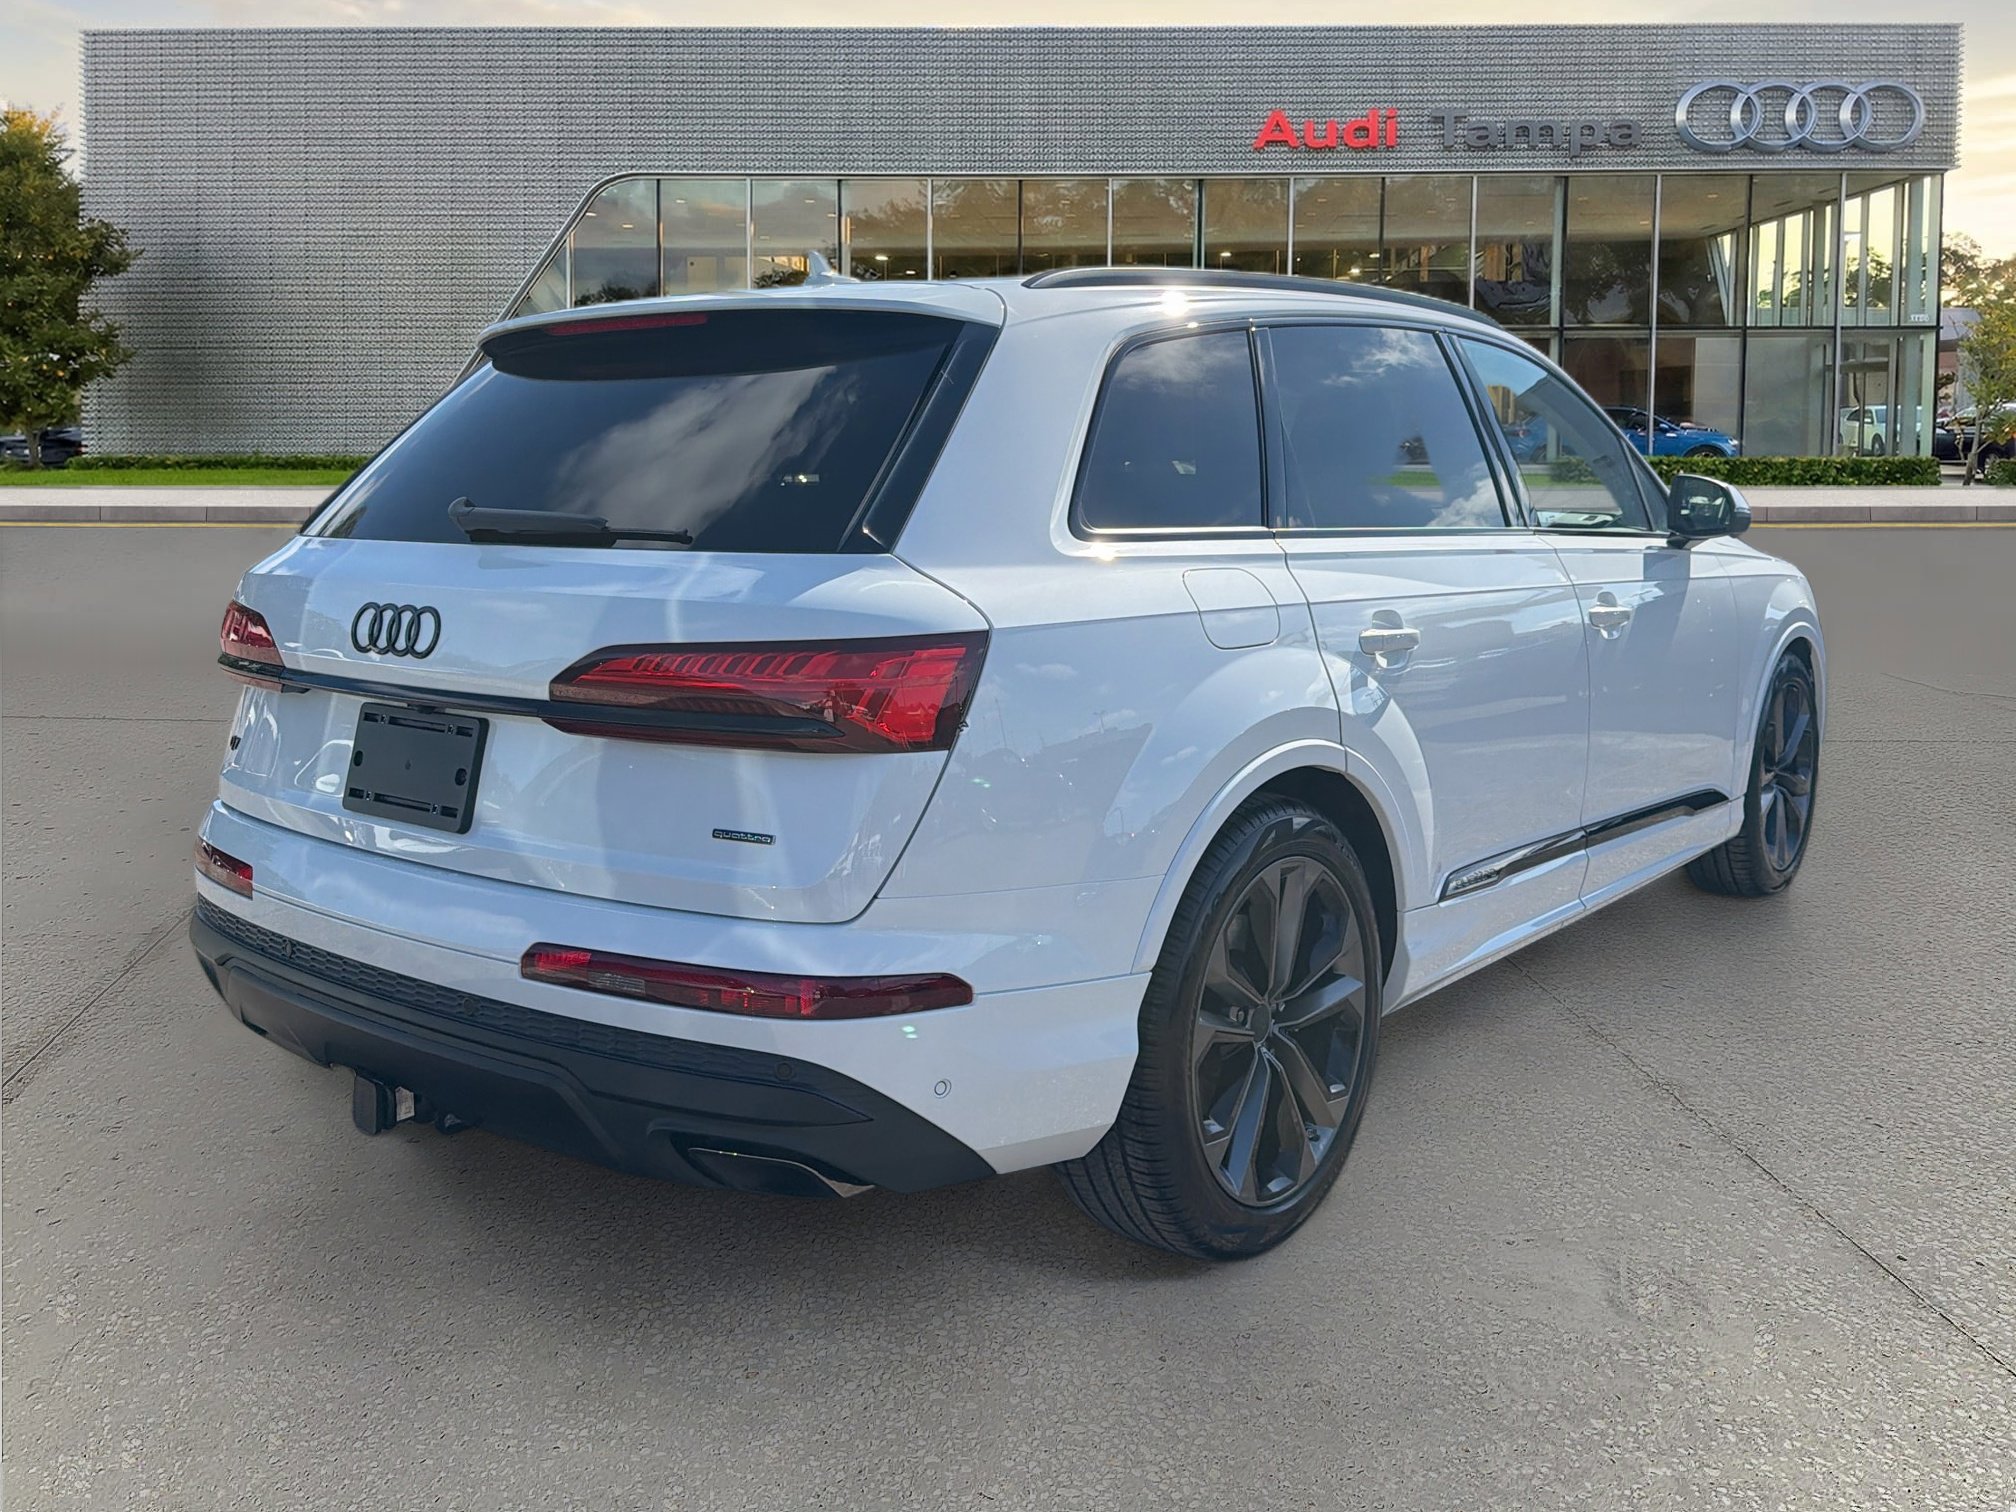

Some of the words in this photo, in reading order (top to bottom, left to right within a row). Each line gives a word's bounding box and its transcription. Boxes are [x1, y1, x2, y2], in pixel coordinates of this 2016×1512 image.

[1253, 107, 1398, 149] Audi
[1431, 108, 1642, 158] Tampa
[713, 829, 772, 844] quattro
